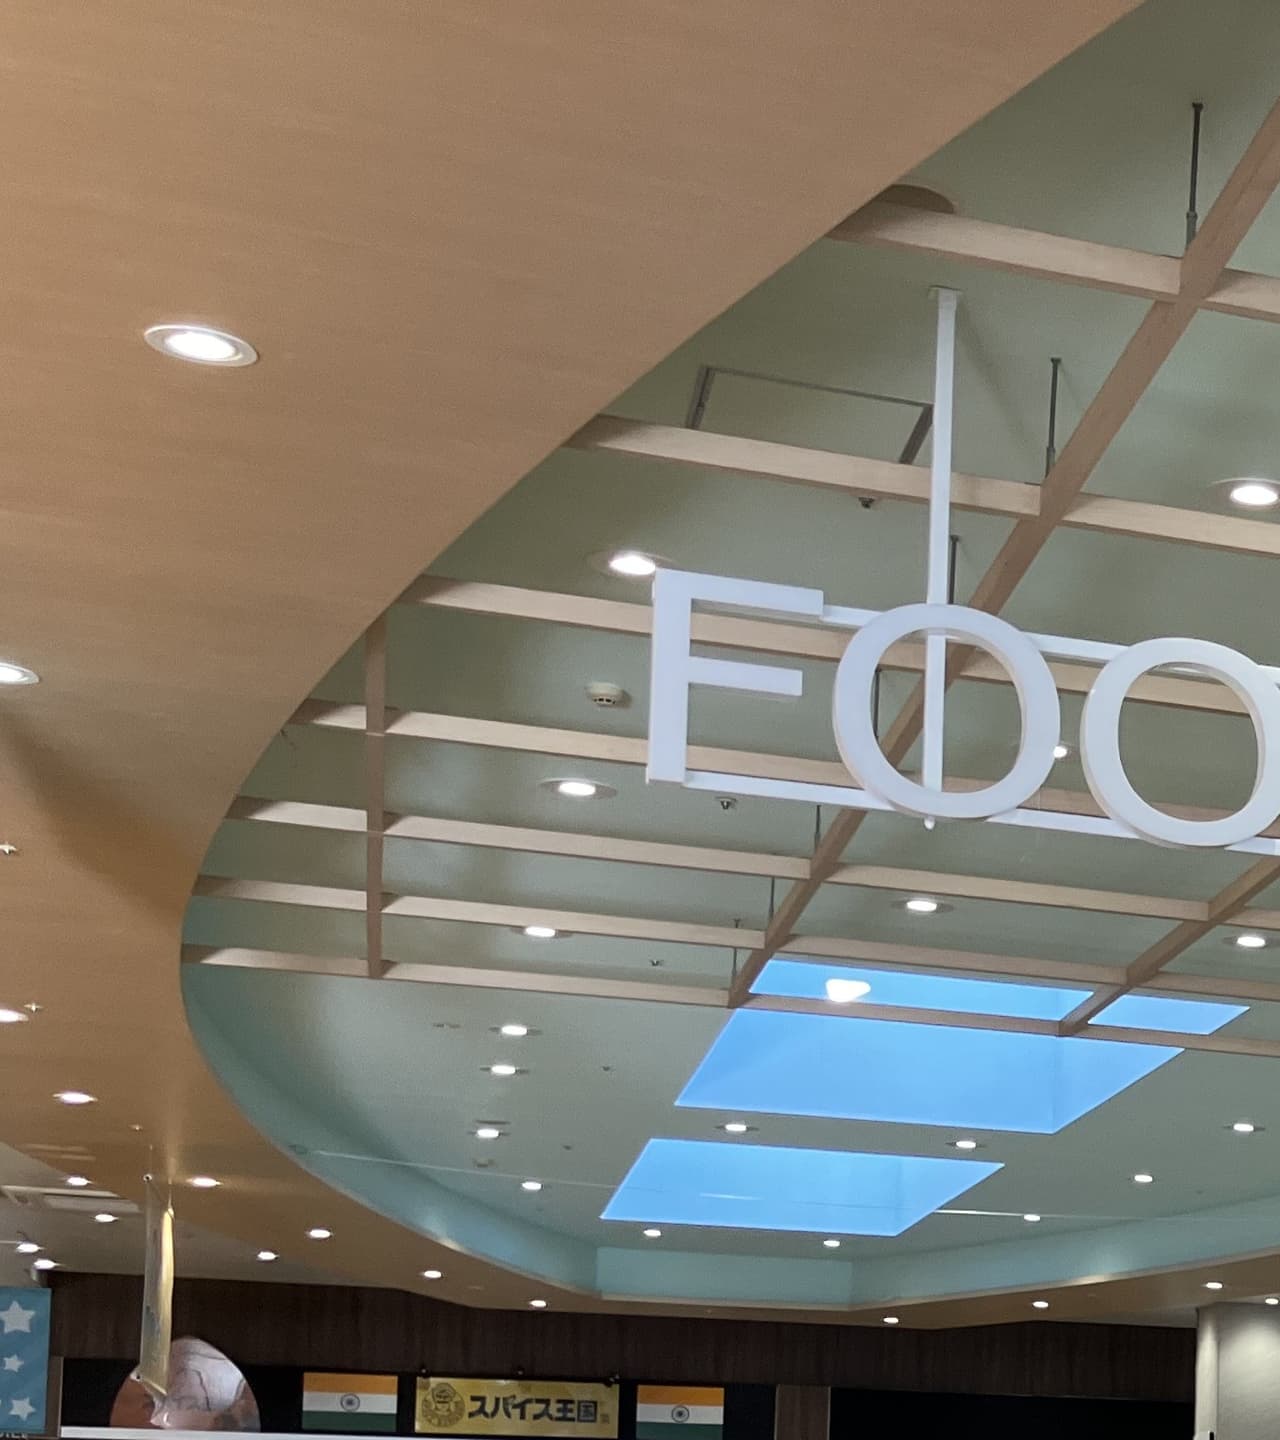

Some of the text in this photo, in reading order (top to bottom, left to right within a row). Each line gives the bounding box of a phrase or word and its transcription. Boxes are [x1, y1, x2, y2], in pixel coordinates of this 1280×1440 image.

[468, 1394, 598, 1423] スパイス王国
